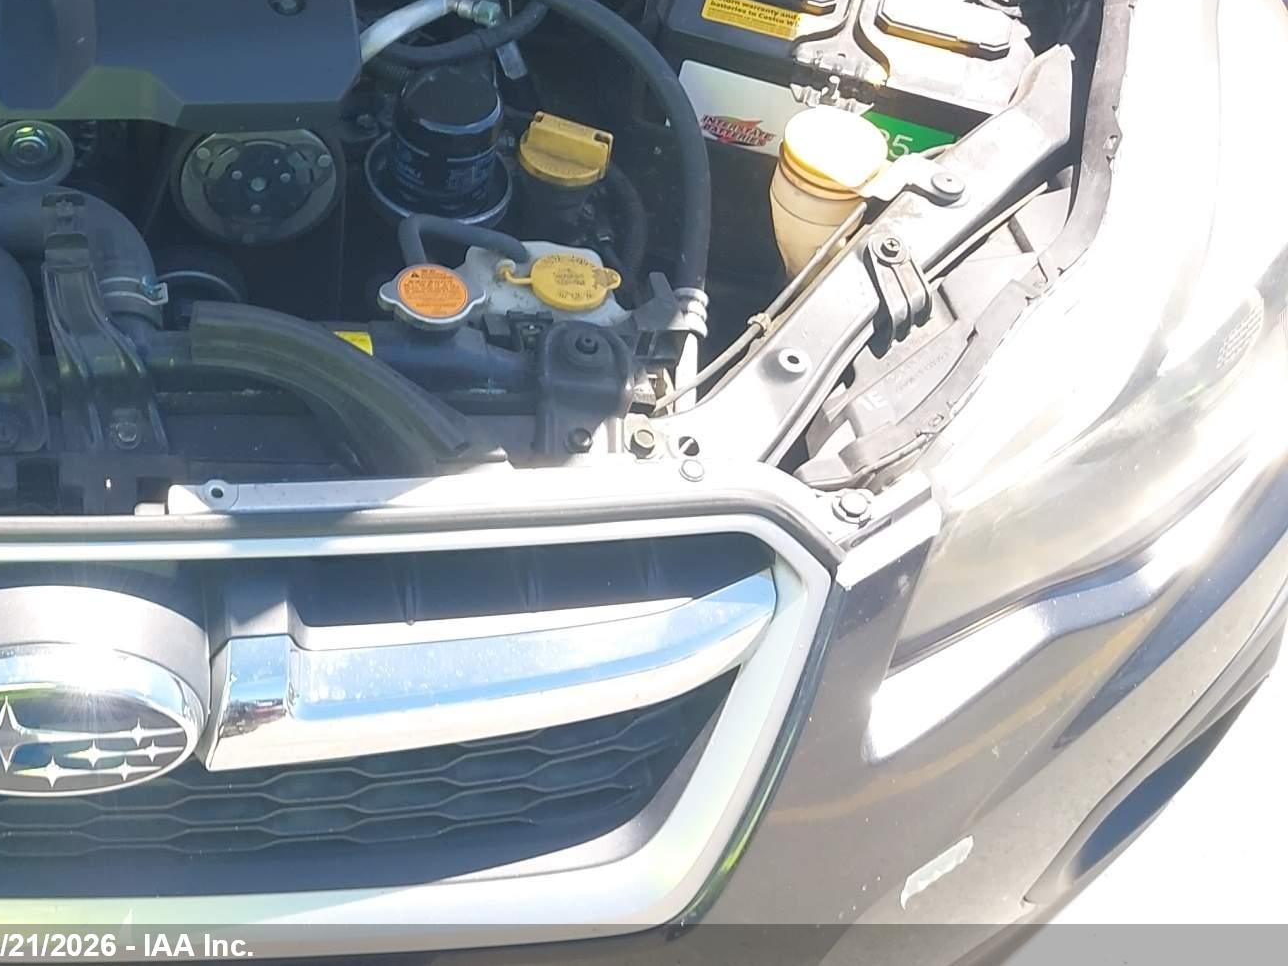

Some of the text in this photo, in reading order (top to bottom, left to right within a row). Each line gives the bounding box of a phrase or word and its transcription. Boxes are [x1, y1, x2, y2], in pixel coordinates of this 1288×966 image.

[710, 0, 747, 14] batteries
[748, 9, 757, 17] to
[758, 12, 785, 25] Costco
[742, 2, 779, 16] warranty
